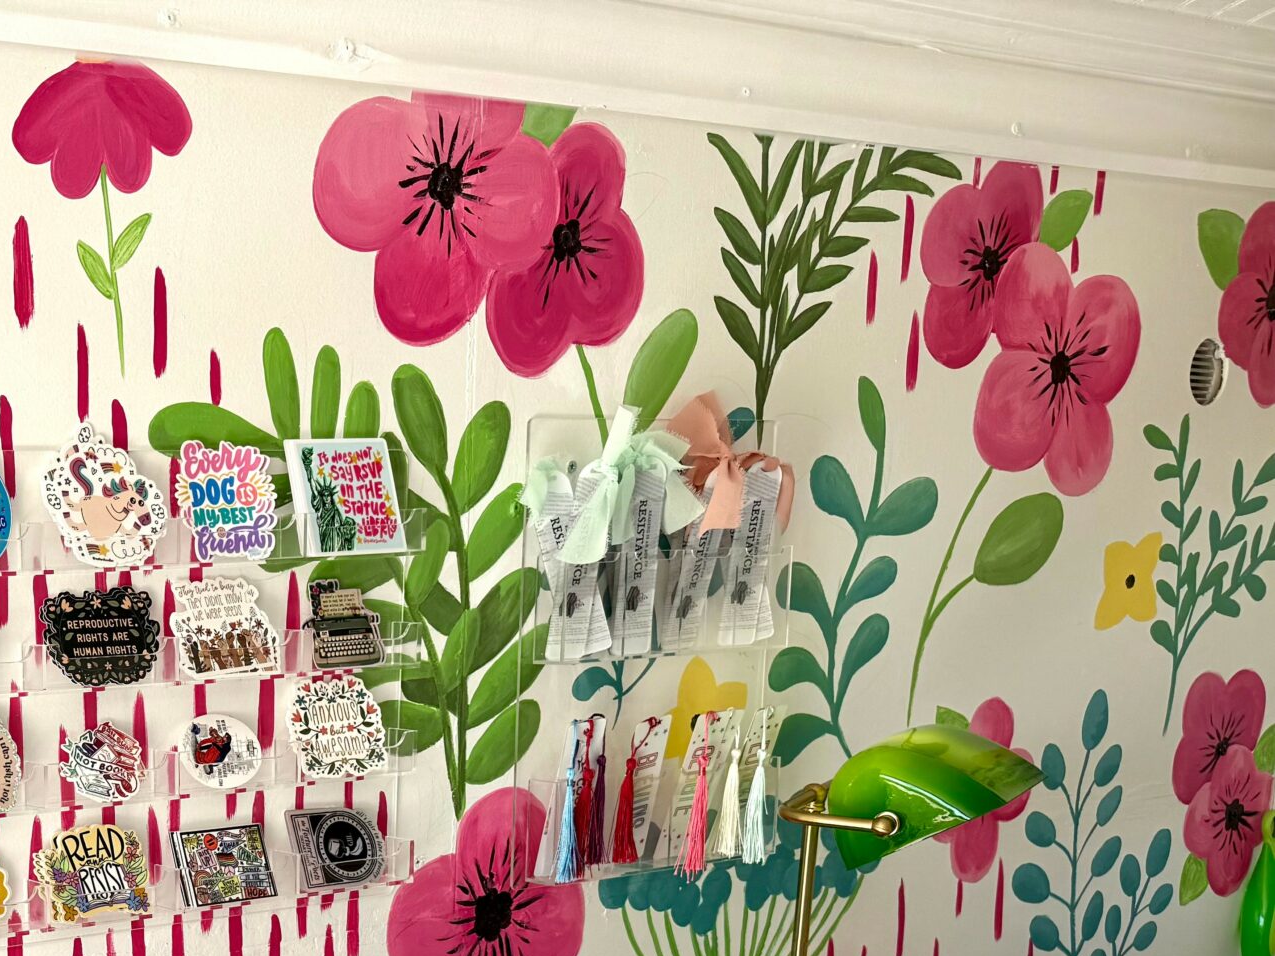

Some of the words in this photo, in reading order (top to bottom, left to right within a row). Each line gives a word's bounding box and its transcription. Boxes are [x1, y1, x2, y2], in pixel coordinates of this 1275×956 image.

[183, 442, 262, 482] Every
[317, 451, 328, 466] It
[332, 450, 352, 464] does
[354, 461, 383, 482] RSVP
[189, 476, 235, 507] DOG
[239, 484, 254, 496] IS
[356, 481, 383, 499] THE
[193, 508, 220, 528] MY
[219, 506, 256, 525] BEST
[195, 515, 268, 559] friend
[175, 585, 194, 597] They
[195, 582, 210, 594] tried
[211, 583, 218, 591] to
[219, 580, 235, 592] bury
[186, 597, 202, 609] THEY
[225, 592, 243, 604] KNOW
[192, 610, 204, 621] WE
[205, 608, 222, 620] WERE
[224, 605, 243, 617] SEEDS
[67, 618, 134, 630] REPRODUCTIVE
[77, 632, 108, 642] RIGHTS
[112, 632, 129, 641] ARE
[73, 647, 103, 656] HUMAN
[106, 645, 138, 655] RIGHTS
[311, 701, 357, 725] ANXIOUS
[330, 724, 347, 736] but
[76, 752, 97, 768] NOT
[0, 786, 9, 803] not
[62, 828, 124, 872] READ
[303, 827, 315, 861] Tortured
[80, 854, 108, 866] and
